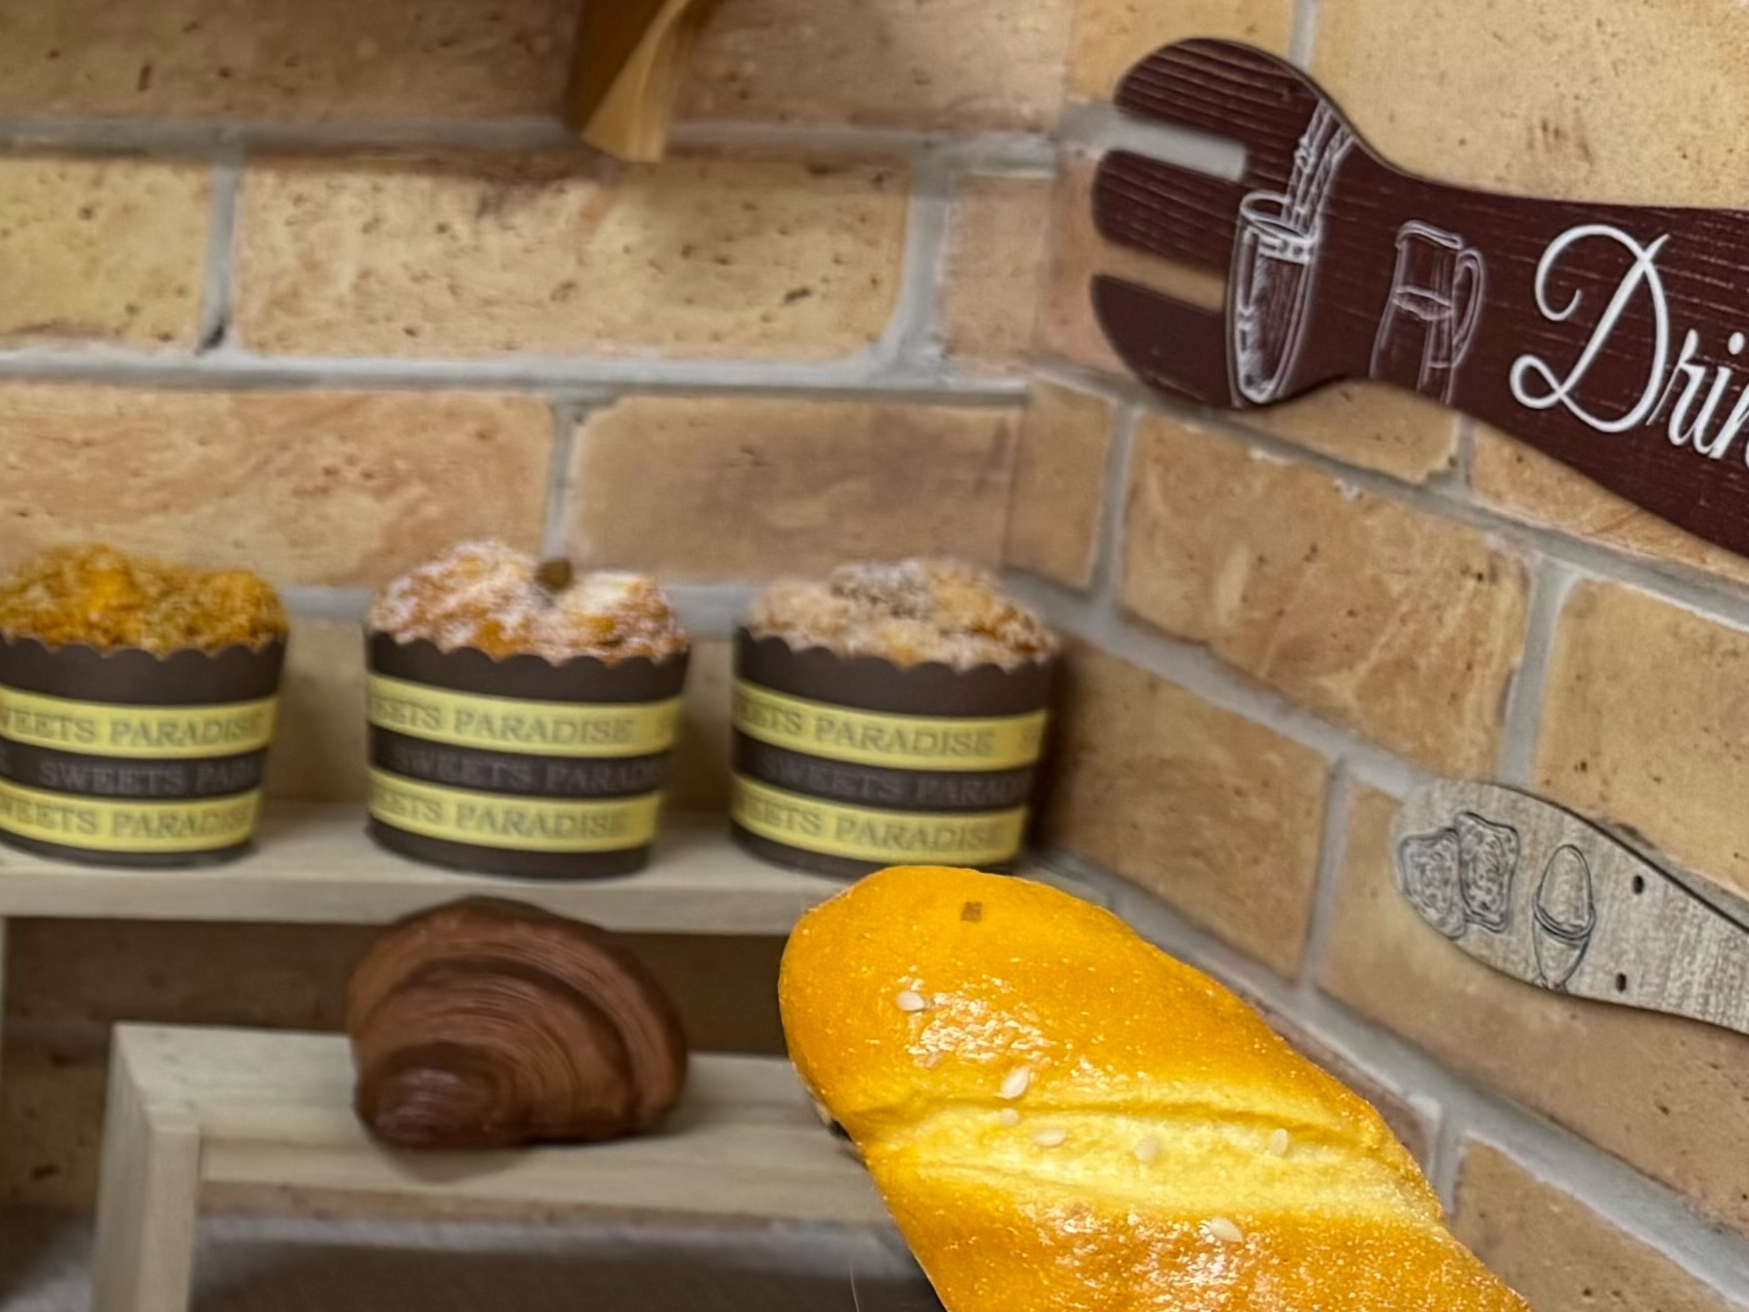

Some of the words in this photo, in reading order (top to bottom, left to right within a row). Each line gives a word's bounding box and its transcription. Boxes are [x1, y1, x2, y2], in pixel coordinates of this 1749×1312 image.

[109, 709, 260, 747] PARADIS
[453, 707, 632, 746] PARADISE
[815, 715, 994, 756] PARADISE
[456, 801, 629, 839] PARADISE
